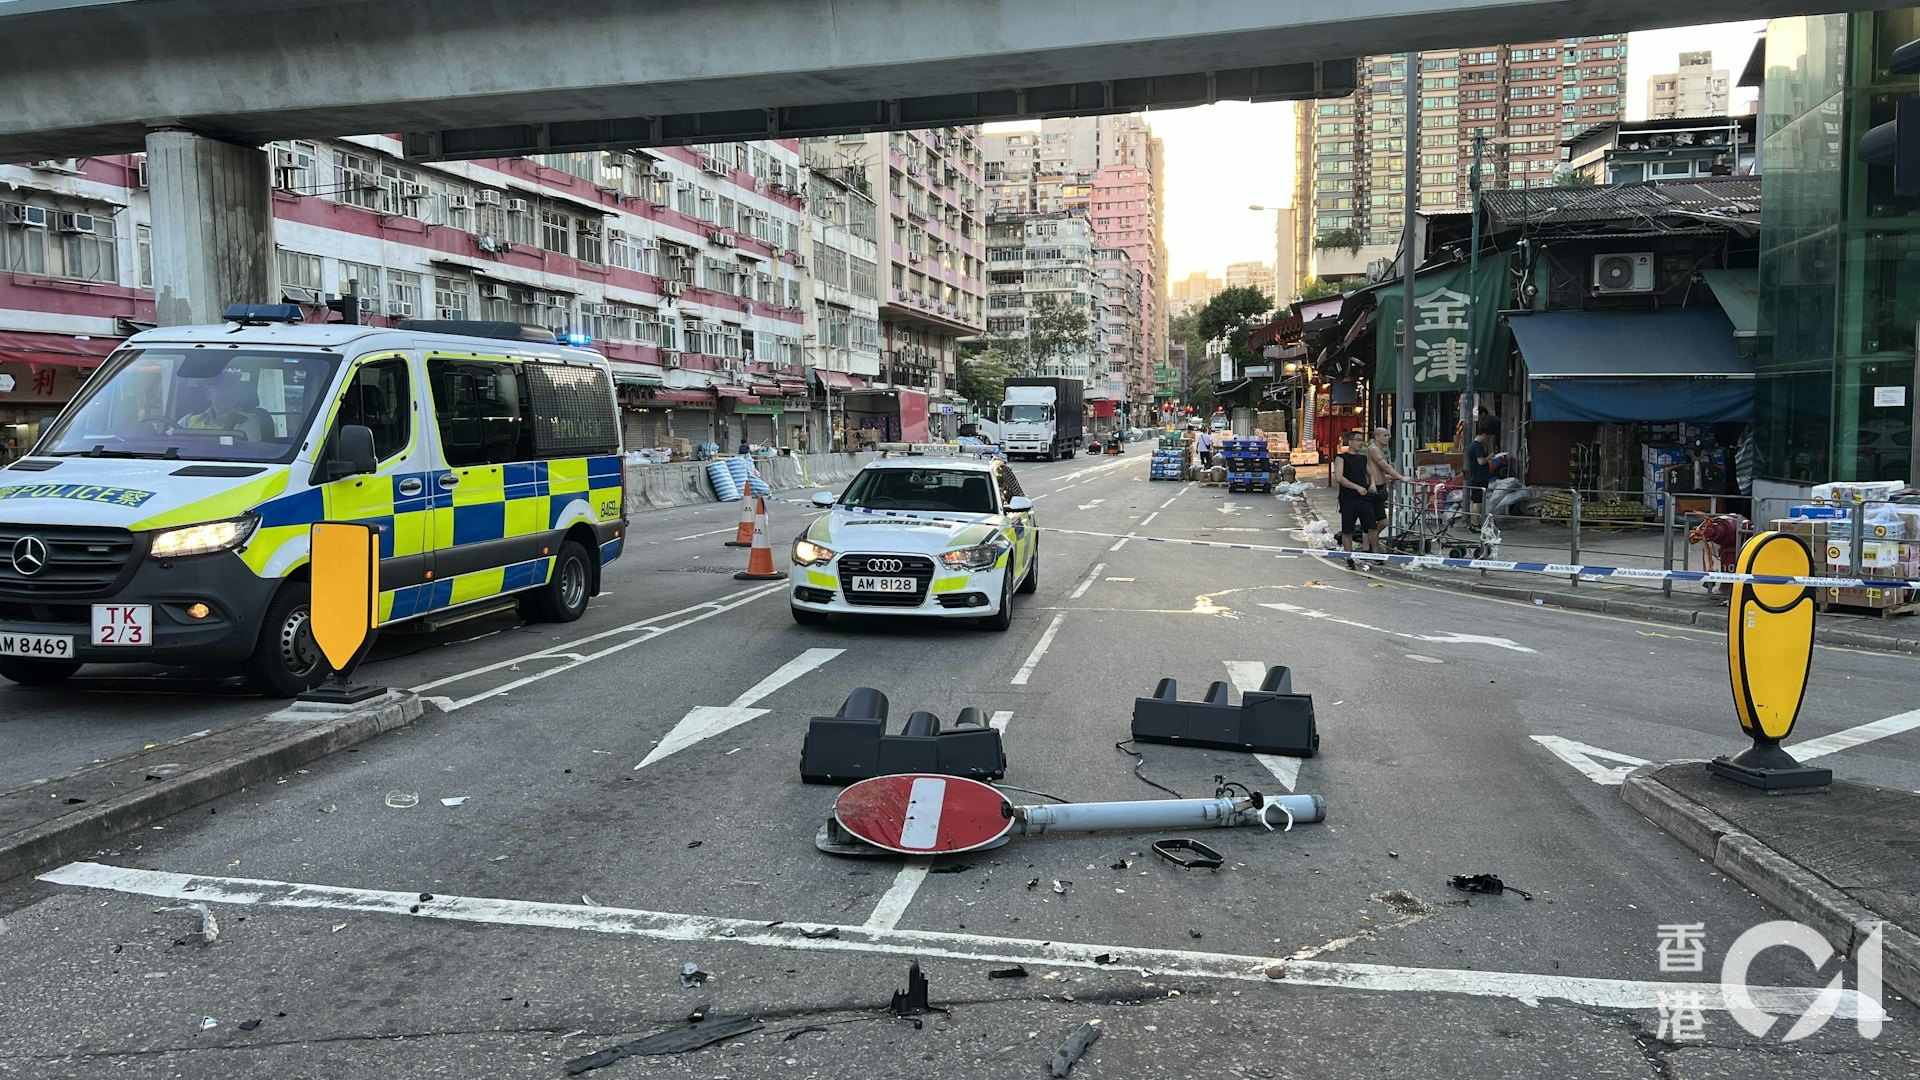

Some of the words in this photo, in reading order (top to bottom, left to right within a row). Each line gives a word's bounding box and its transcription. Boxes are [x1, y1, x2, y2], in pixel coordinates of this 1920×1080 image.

[1413, 286, 1480, 383] 金津
[32, 368, 57, 396] 利
[11, 484, 122, 502] POLICE
[857, 578, 875, 589] AM
[880, 579, 912, 591] 8128
[106, 607, 137, 625] TK
[101, 625, 142, 643] 2/3
[0, 636, 14, 653] M
[20, 637, 67, 655] 8469
